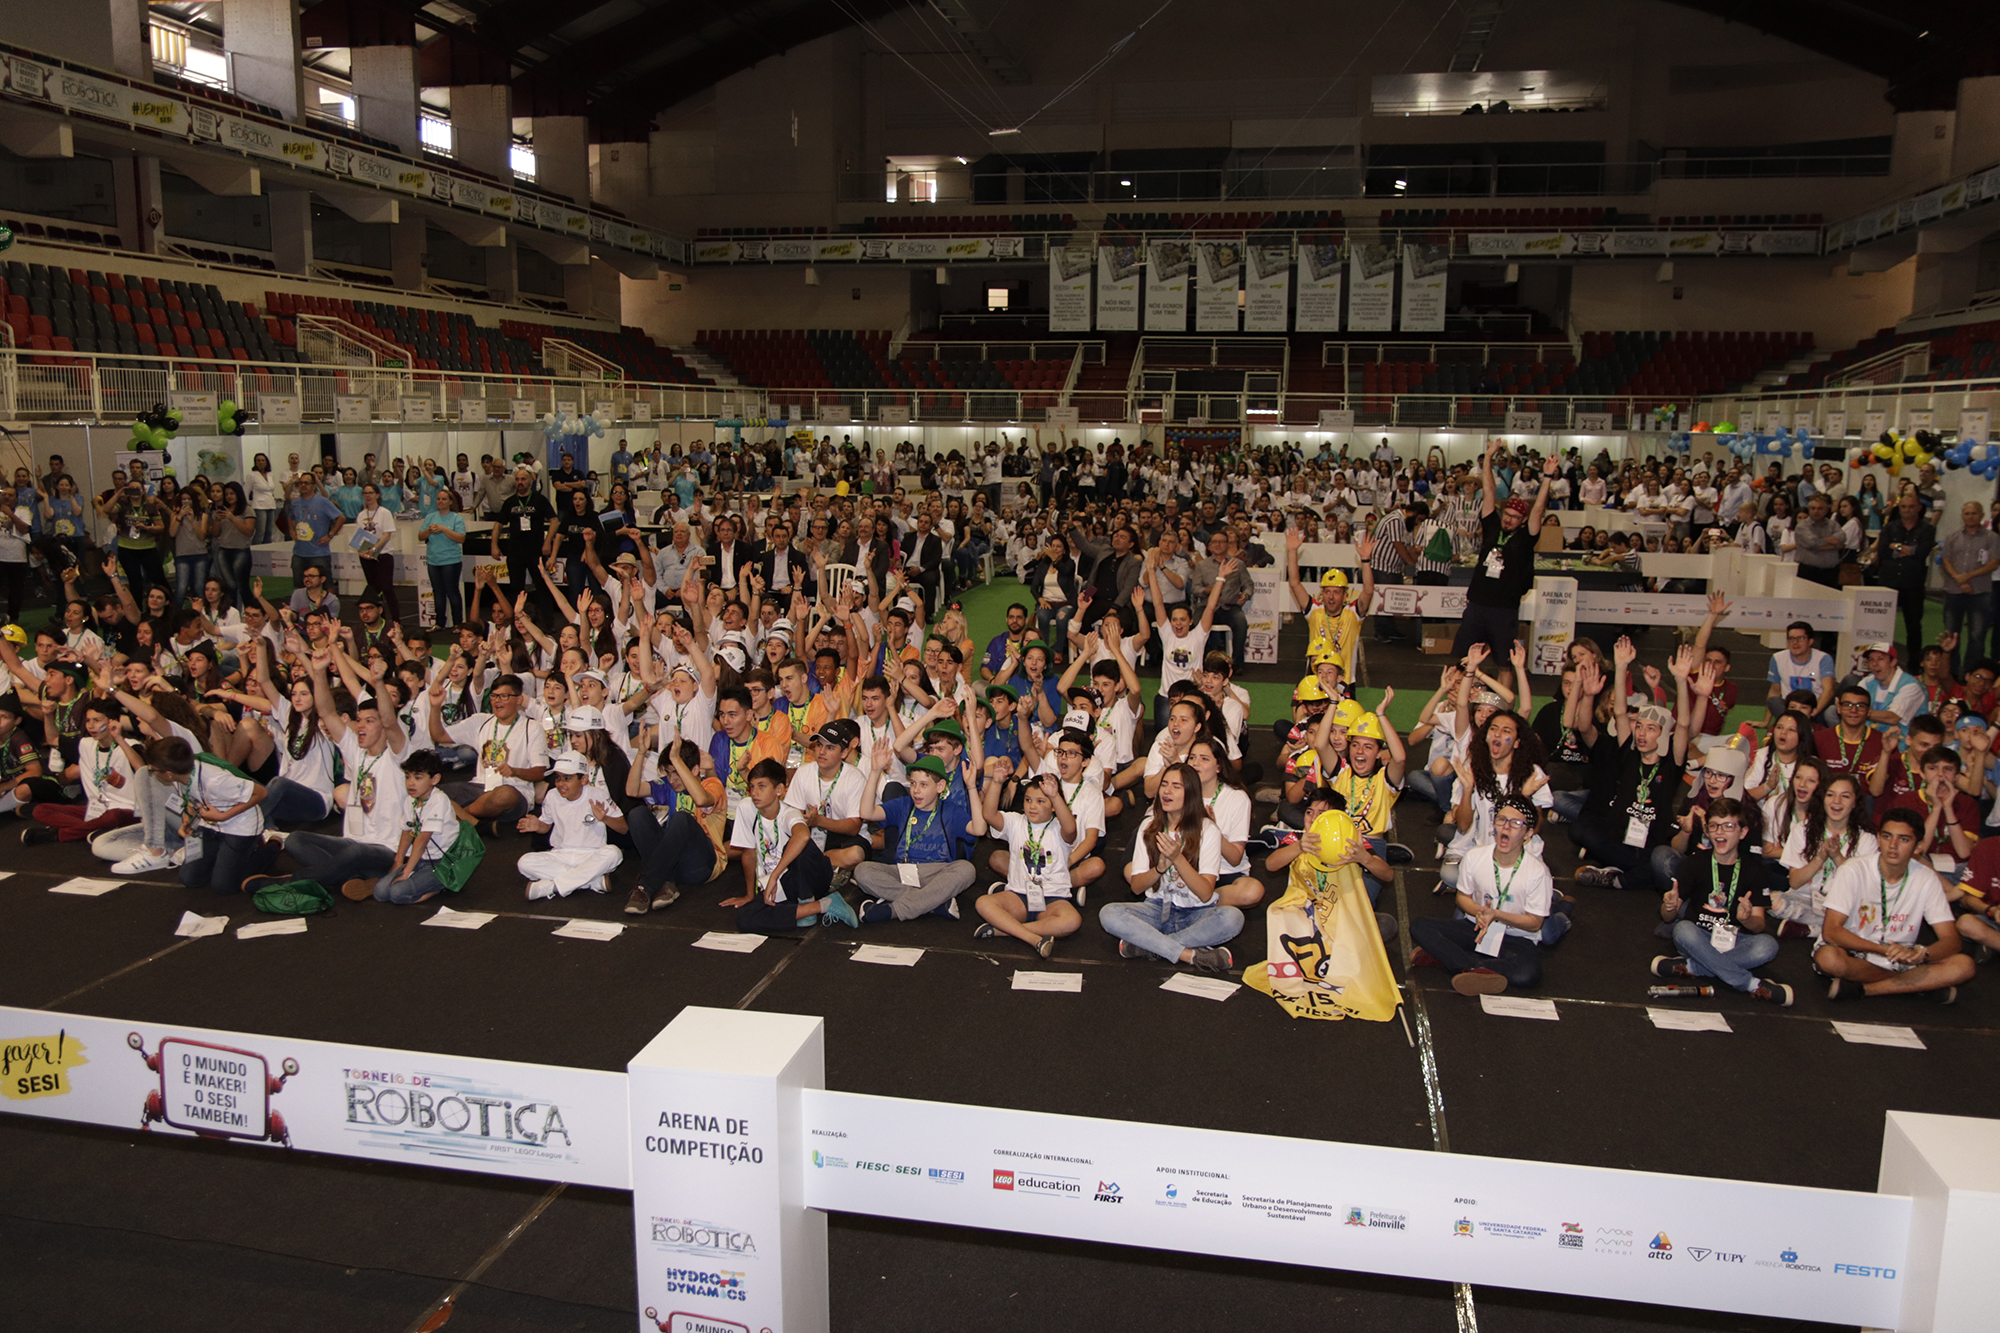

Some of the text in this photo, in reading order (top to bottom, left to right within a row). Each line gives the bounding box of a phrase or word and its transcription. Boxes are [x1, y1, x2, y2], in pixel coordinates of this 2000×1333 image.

[385, 360, 404, 368] SAÍDA
[182, 1053, 248, 1077] O MUNDO
[17, 1072, 60, 1095] SESI
[183, 1067, 247, 1094] É MAKER!
[343, 1068, 432, 1088] TORNEIO DE
[194, 1089, 237, 1109] O SESI
[184, 1104, 248, 1128] TAMBÉM!
[658, 1111, 749, 1136] ARENA DE
[811, 1129, 849, 1139] REALIZAÇÃO:
[536, 1149, 563, 1160] League
[645, 1135, 764, 1166] COMPETIÇÃO
[993, 1148, 1095, 1166] CORREALIZAÇÃO INTERNACIONAL:
[855, 1160, 891, 1173] FIESC
[895, 1164, 922, 1176] SESI
[1156, 1166, 1231, 1181] APOIO INSTITUCIONAL:
[940, 1169, 963, 1180] SESI
[995, 1175, 1013, 1185] LEGO
[1017, 1176, 1081, 1193] education
[1093, 1193, 1124, 1204] FIRST
[1196, 1189, 1229, 1199] Secretaria
[1201, 1197, 1233, 1206] Educação
[1242, 1194, 1275, 1204] Secretaria
[1286, 1199, 1333, 1210] Planejamento
[1454, 1197, 1478, 1206] APOIO:
[1242, 1202, 1267, 1211] Urbano
[1273, 1206, 1332, 1218] Desenvolvimento
[1369, 1211, 1398, 1221] Prefeitura
[1266, 1211, 1306, 1222] Sustentável
[1368, 1218, 1406, 1230] Joinville
[1479, 1221, 1522, 1231] UNIVERSIDADE
[1512, 1229, 1542, 1237] CATARINA
[1559, 1233, 1584, 1241] GOVERNO
[1594, 1247, 1633, 1256] school
[1648, 1251, 1673, 1261] atto
[1714, 1251, 1747, 1263] TUPY
[1785, 1262, 1822, 1273] ROBÓTICA
[1834, 1262, 1896, 1280] FESTO
[666, 1267, 721, 1286] HYDRO
